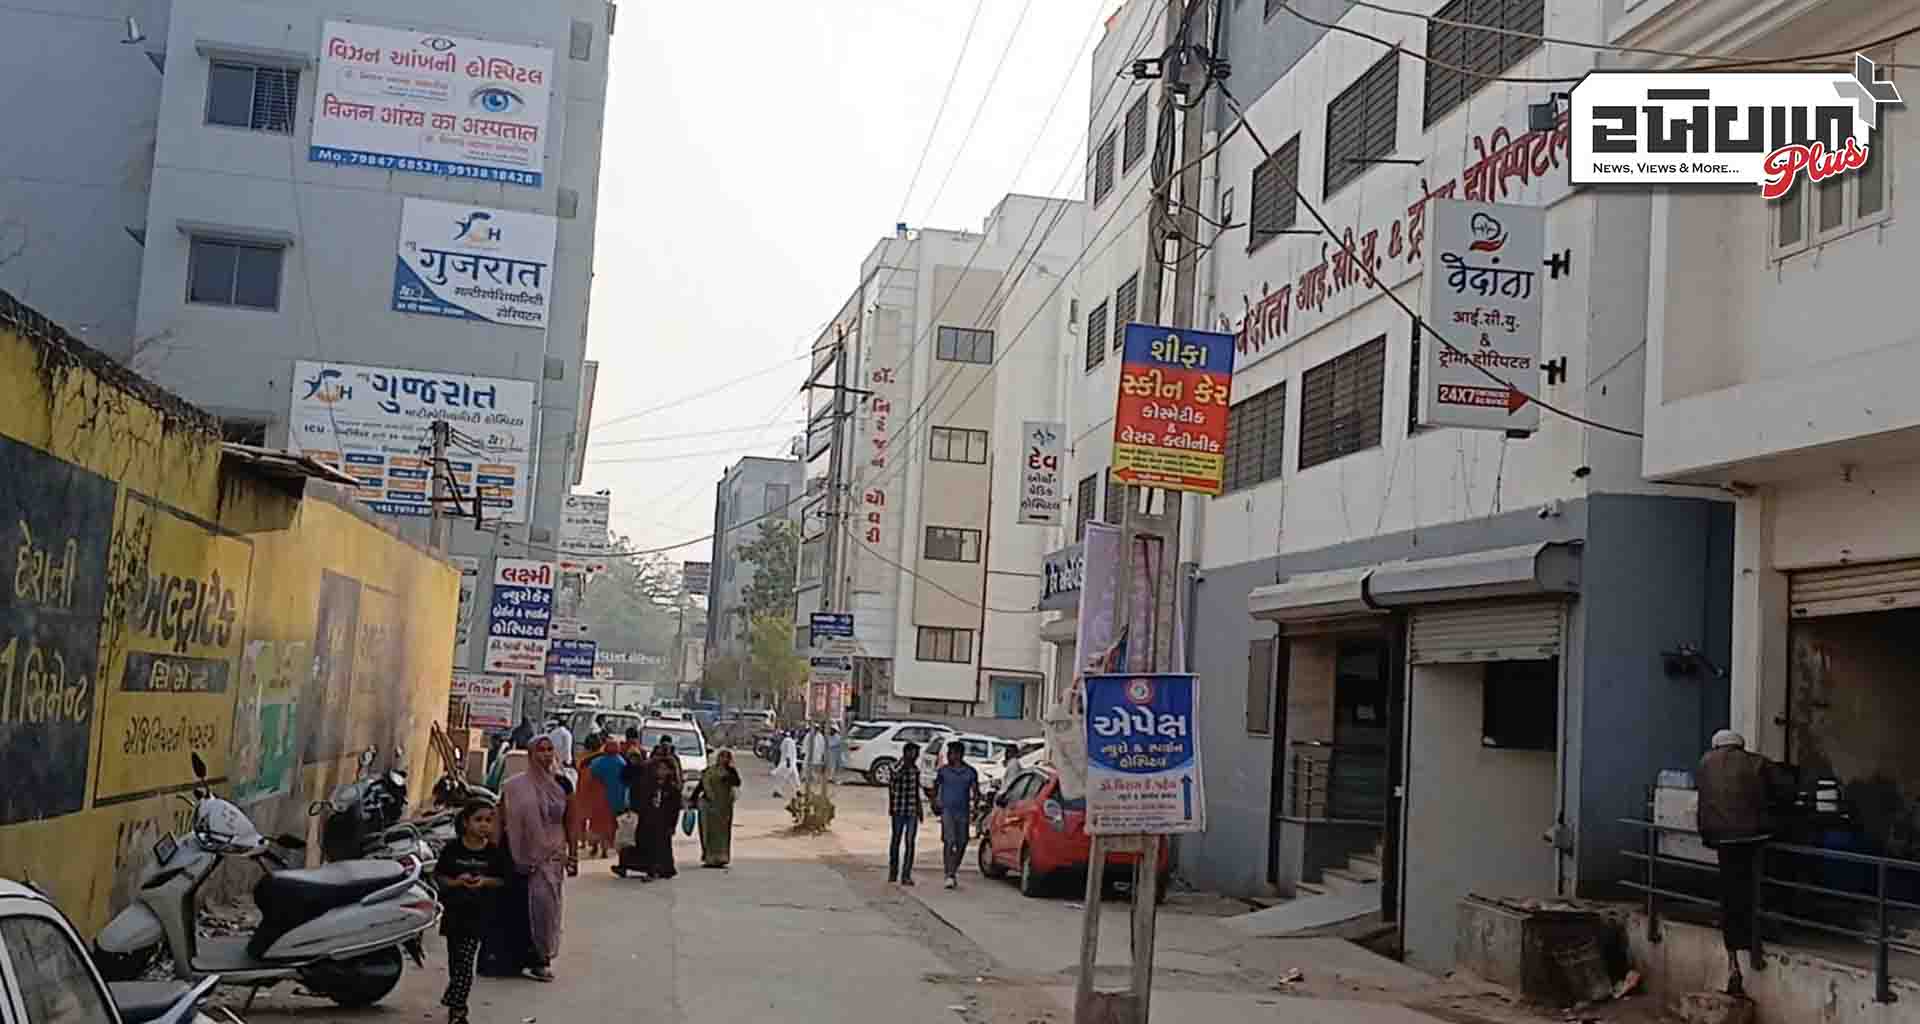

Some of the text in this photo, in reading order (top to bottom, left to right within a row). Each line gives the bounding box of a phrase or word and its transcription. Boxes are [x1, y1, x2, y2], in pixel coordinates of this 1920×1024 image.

[328, 38, 381, 65] વિઝન
[389, 50, 456, 73] આંખની
[465, 56, 543, 85] હોસ્પિટલ
[322, 92, 375, 122] विजन
[431, 113, 456, 133] का
[463, 118, 538, 144] अस्पताल
[419, 248, 548, 289] गुजरात
[1151, 334, 1208, 368] શીફા
[1480, 333, 1490, 347] &
[372, 373, 496, 415] ગુજરાત
[1122, 369, 1230, 405] સ્કીન કેર
[1440, 386, 1475, 404] 24X7
[1028, 446, 1058, 472] દેવ
[1093, 706, 1187, 739] એપેક્ષ
